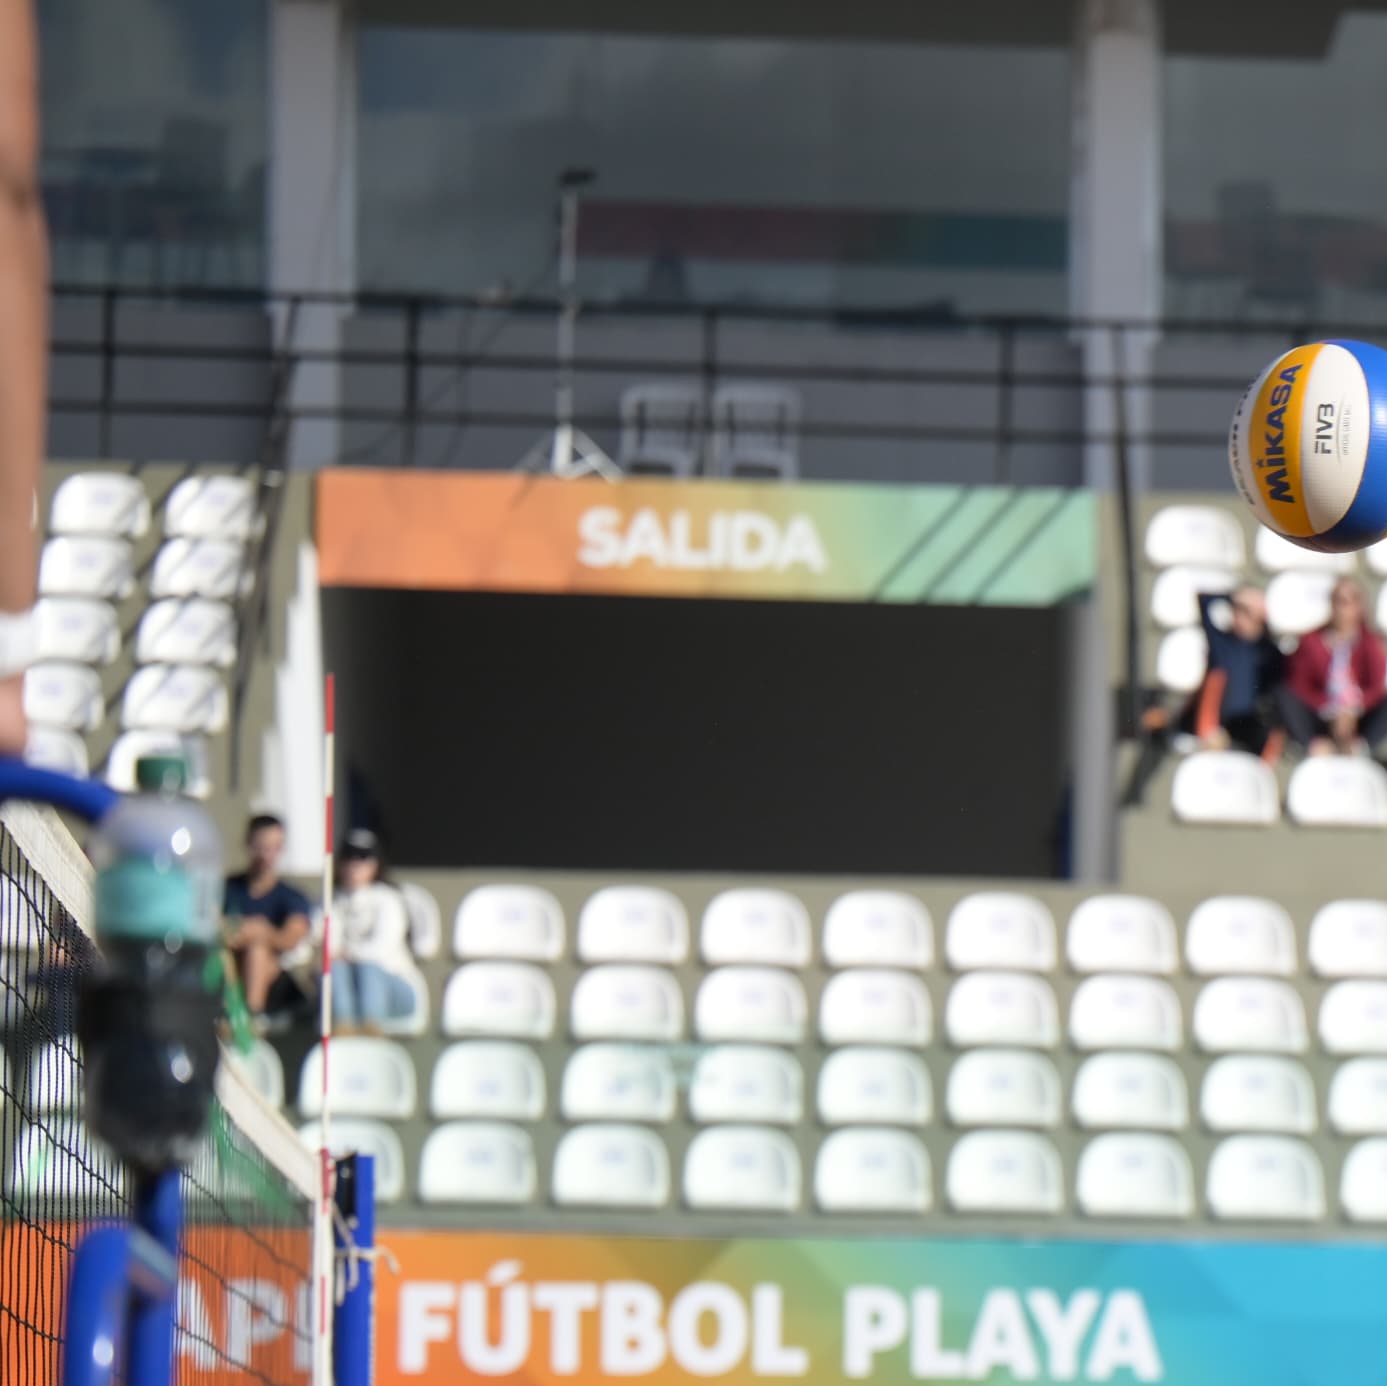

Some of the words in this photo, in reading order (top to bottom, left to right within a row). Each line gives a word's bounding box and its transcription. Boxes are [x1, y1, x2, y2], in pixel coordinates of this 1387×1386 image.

[1257, 364, 1303, 503] MIKASA
[578, 505, 826, 573] SALIDA
[398, 1260, 808, 1376] FÚTBOL
[842, 1286, 1162, 1382] PLAYA
